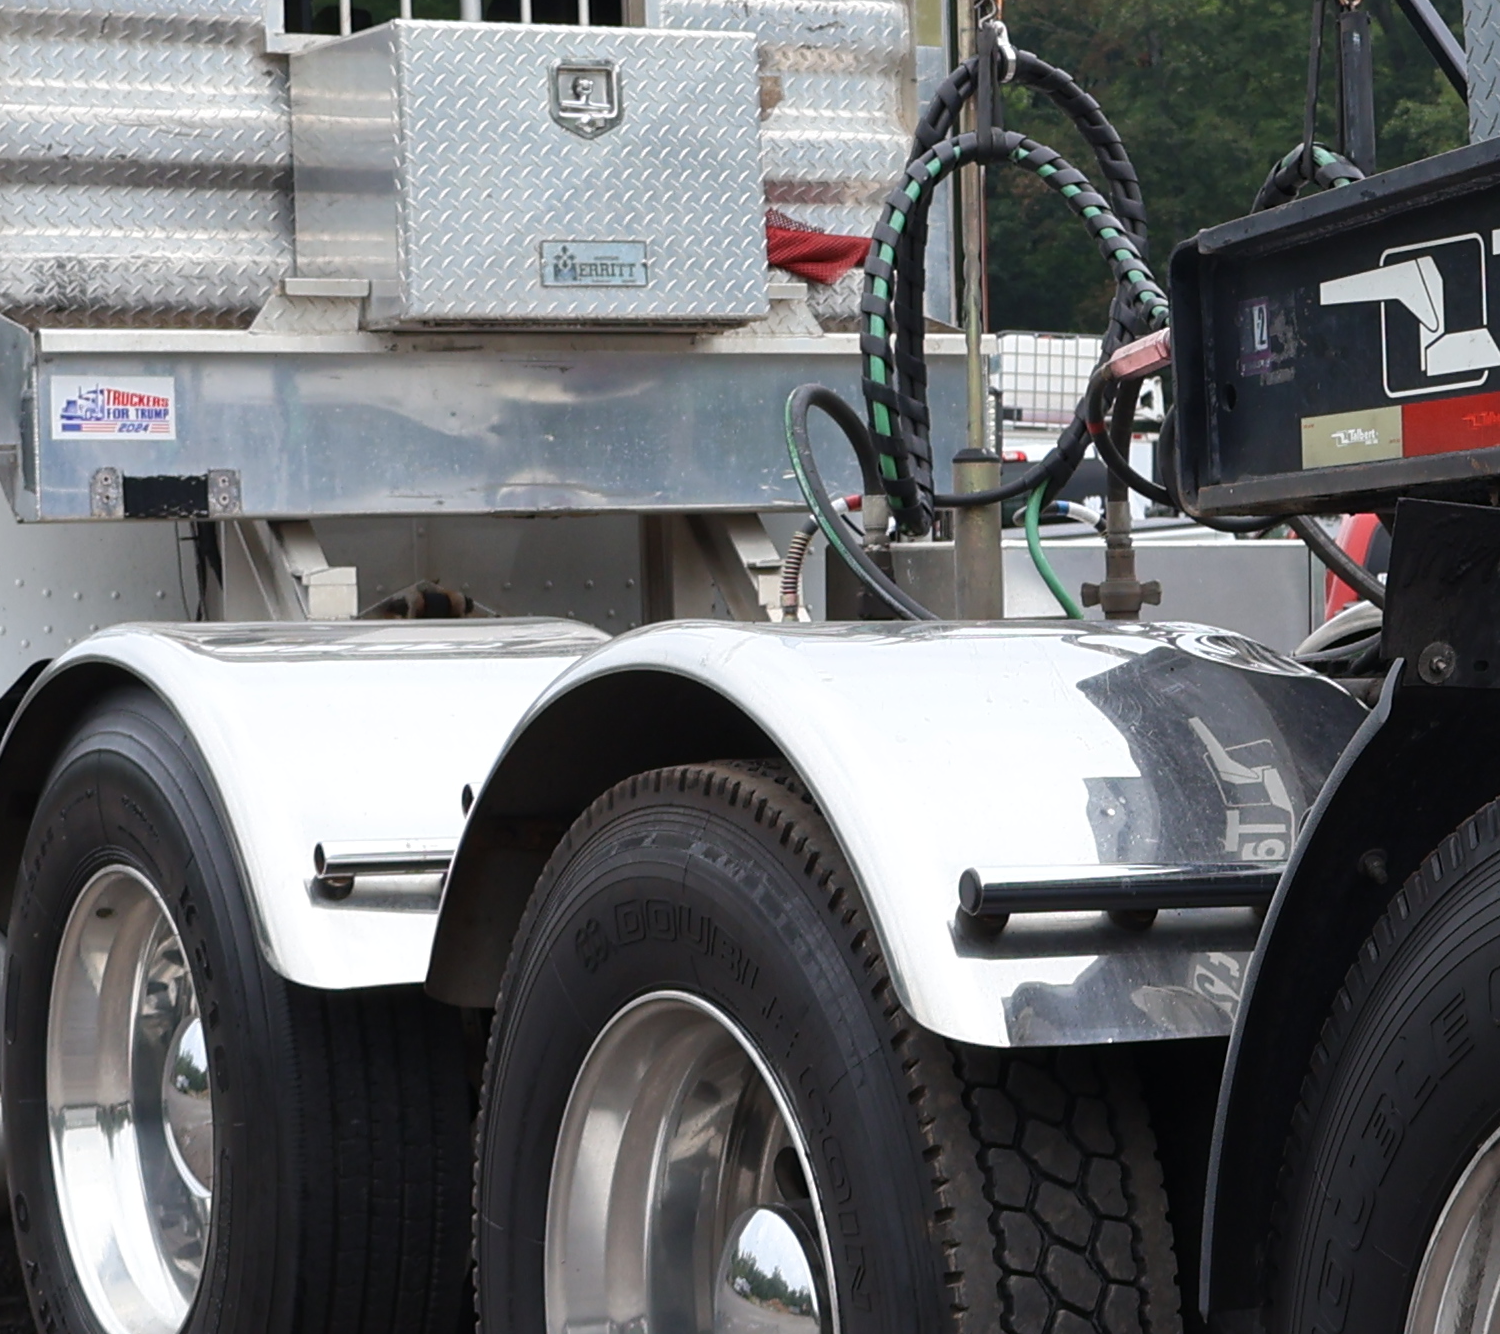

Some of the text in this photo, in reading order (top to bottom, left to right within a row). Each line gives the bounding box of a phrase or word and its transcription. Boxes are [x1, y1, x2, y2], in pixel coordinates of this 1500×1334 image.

[106, 388, 169, 407] TRUCKERS
[107, 408, 169, 419] FOR TRUMP
[117, 423, 150, 433] 2024
